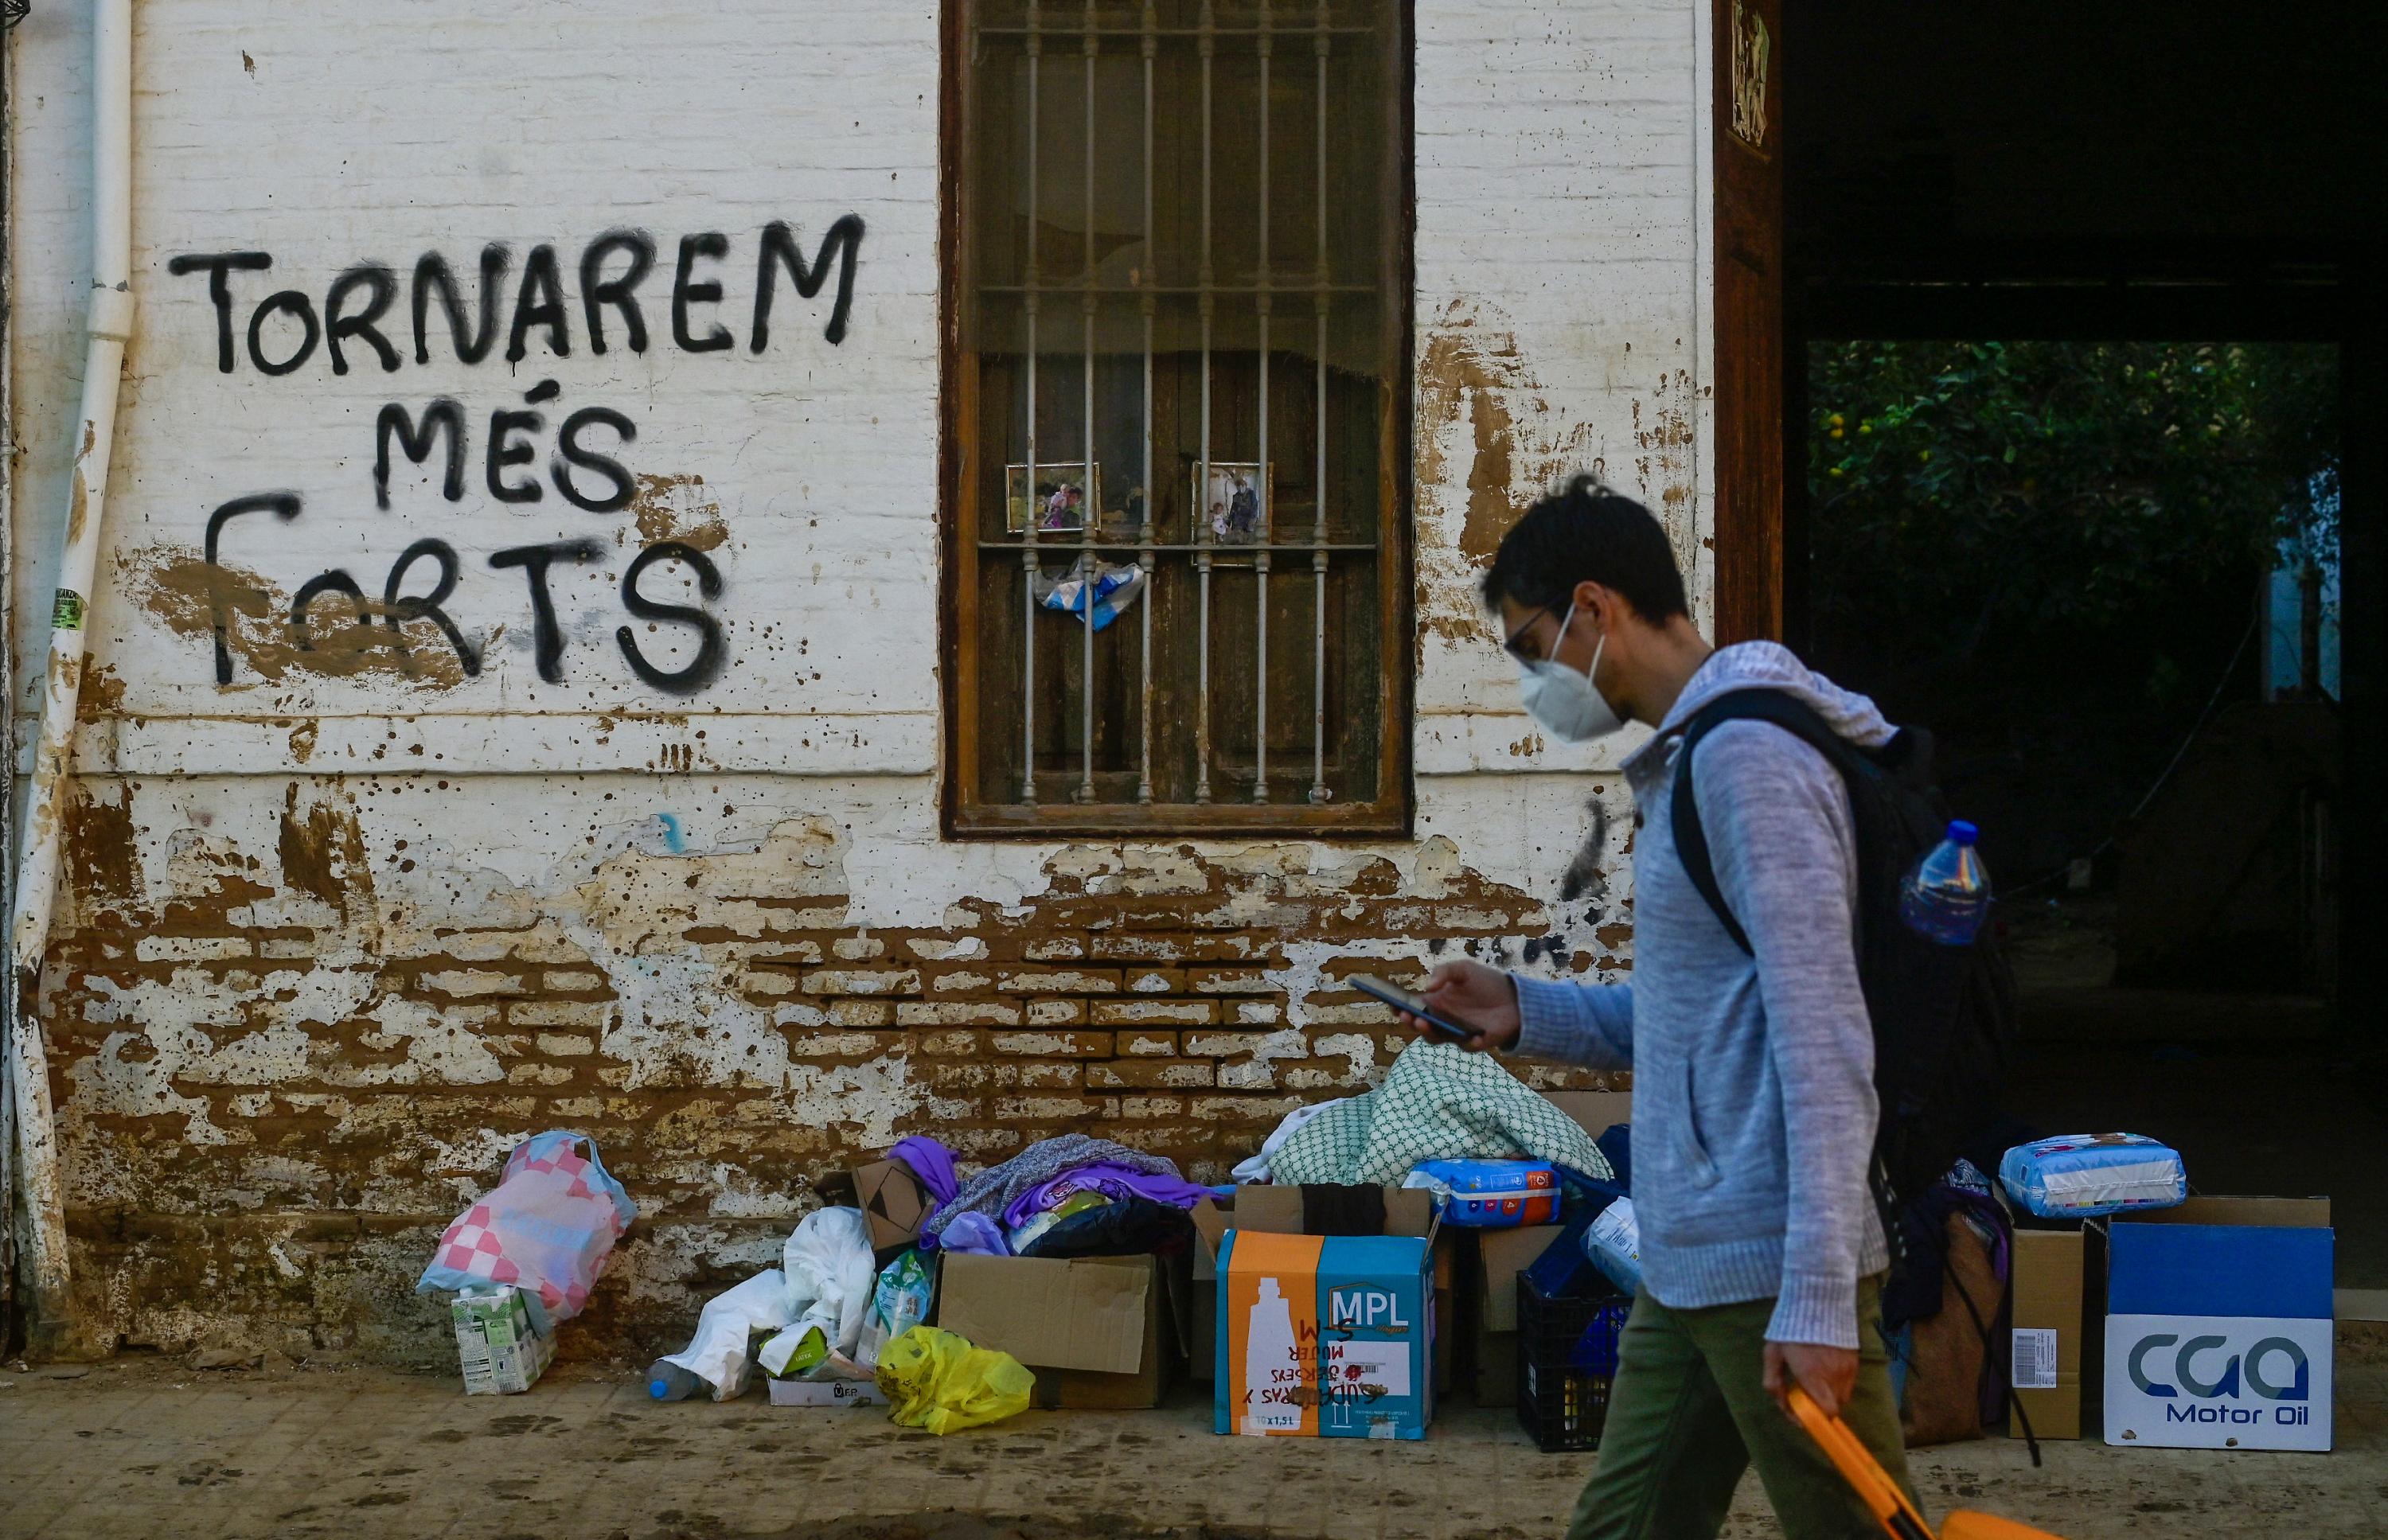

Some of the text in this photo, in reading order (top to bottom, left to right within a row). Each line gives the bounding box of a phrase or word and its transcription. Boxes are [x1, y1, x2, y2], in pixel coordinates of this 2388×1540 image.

[169, 213, 866, 376] TORNAREM
[374, 379, 638, 513] MÉS
[1333, 1292, 1409, 1326] MPL
[1288, 1345, 1344, 1360] MUJER
[2167, 1403, 2308, 1425] Motor Oil
